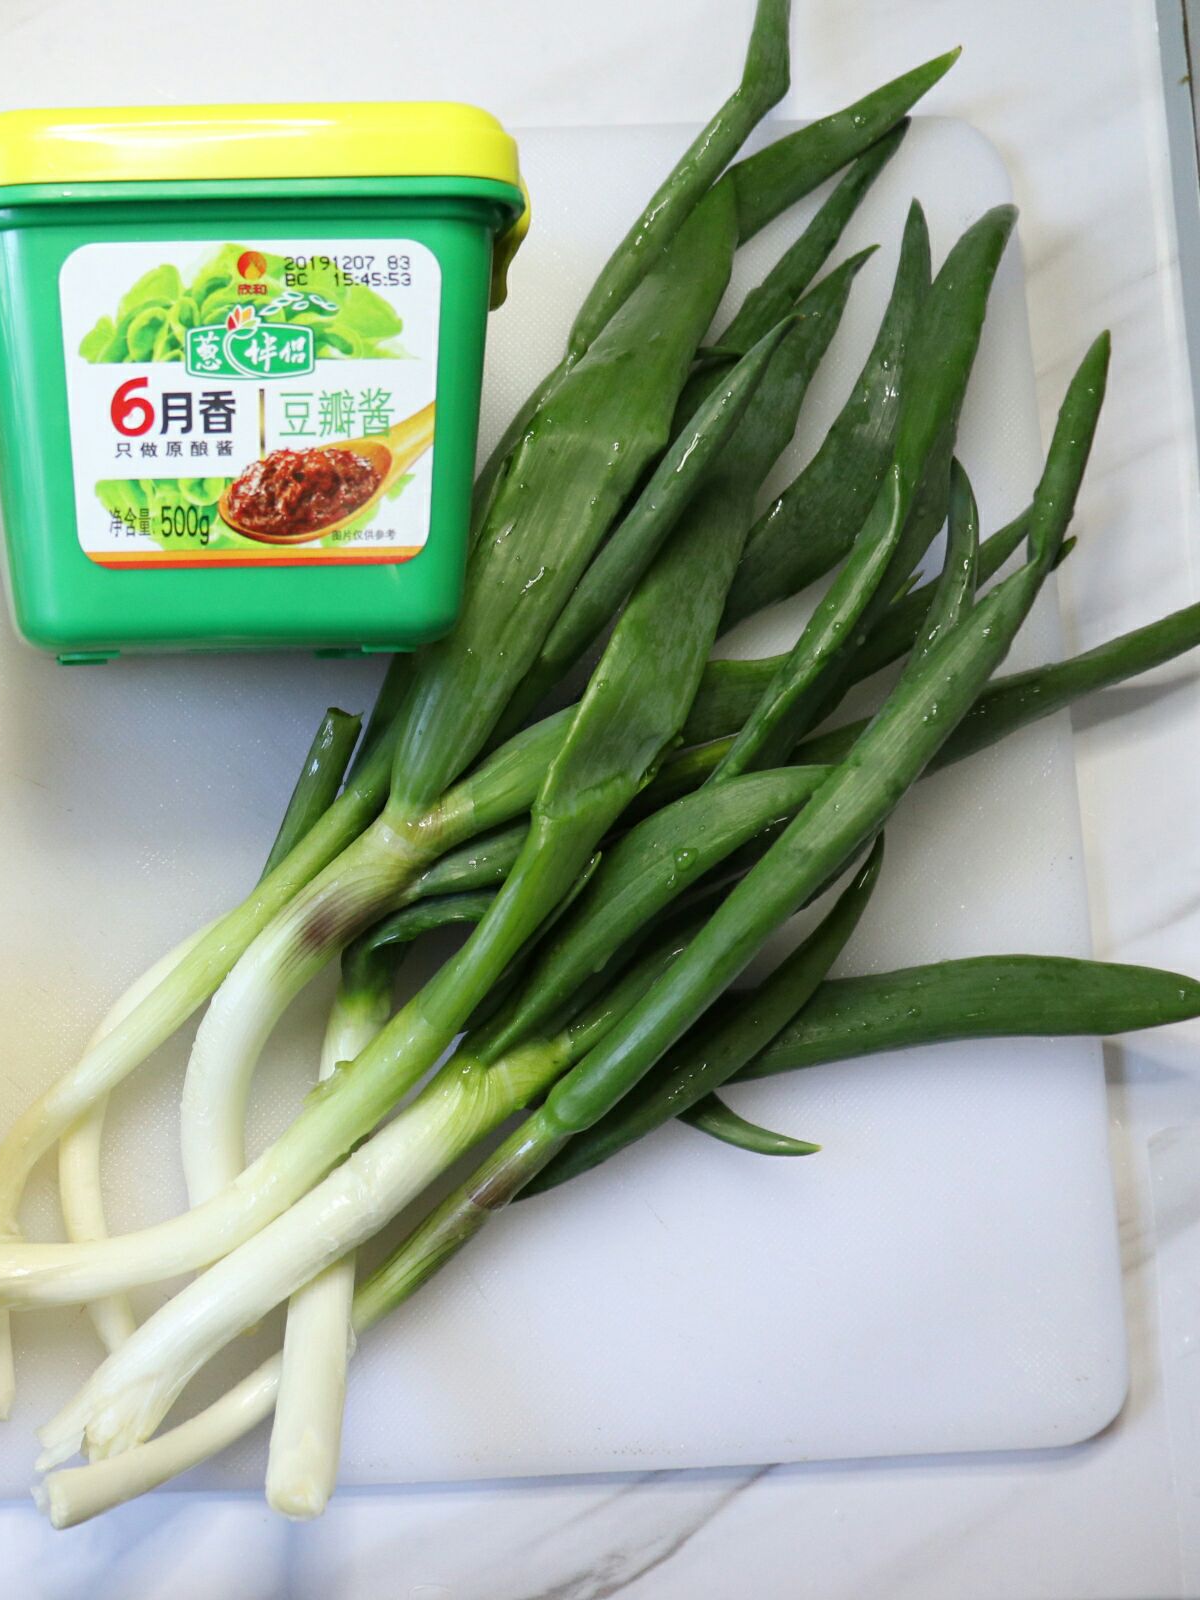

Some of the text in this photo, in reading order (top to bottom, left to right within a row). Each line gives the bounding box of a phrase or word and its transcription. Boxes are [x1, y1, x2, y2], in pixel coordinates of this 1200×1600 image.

[284, 255, 411, 271] 20191207 83
[285, 272, 412, 287] BC 15:45:53
[237, 284, 268, 296] 欣和
[110, 376, 237, 437] 6月香
[279, 387, 396, 440] 豆瓣酱
[114, 440, 235, 459] 只做原酿酱
[160, 505, 210, 546] 500g
